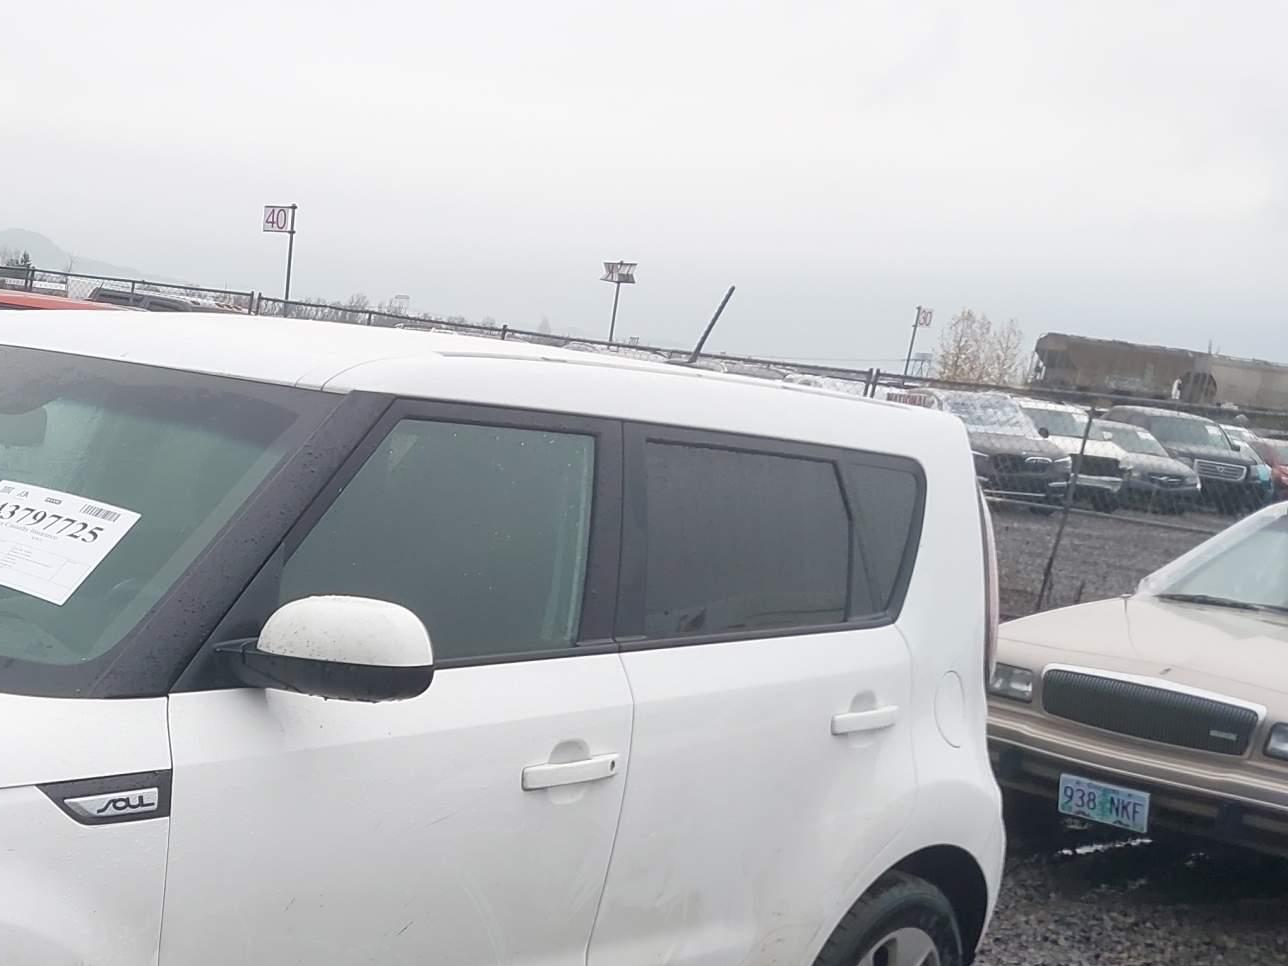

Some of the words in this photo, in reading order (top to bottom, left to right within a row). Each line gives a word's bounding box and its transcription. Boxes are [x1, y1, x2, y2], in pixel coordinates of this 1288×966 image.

[265, 208, 287, 230] 40
[918, 310, 932, 327] 30
[96, 795, 155, 814] SOUL
[1063, 785, 1097, 810] 938
[1109, 795, 1144, 823] NKF
